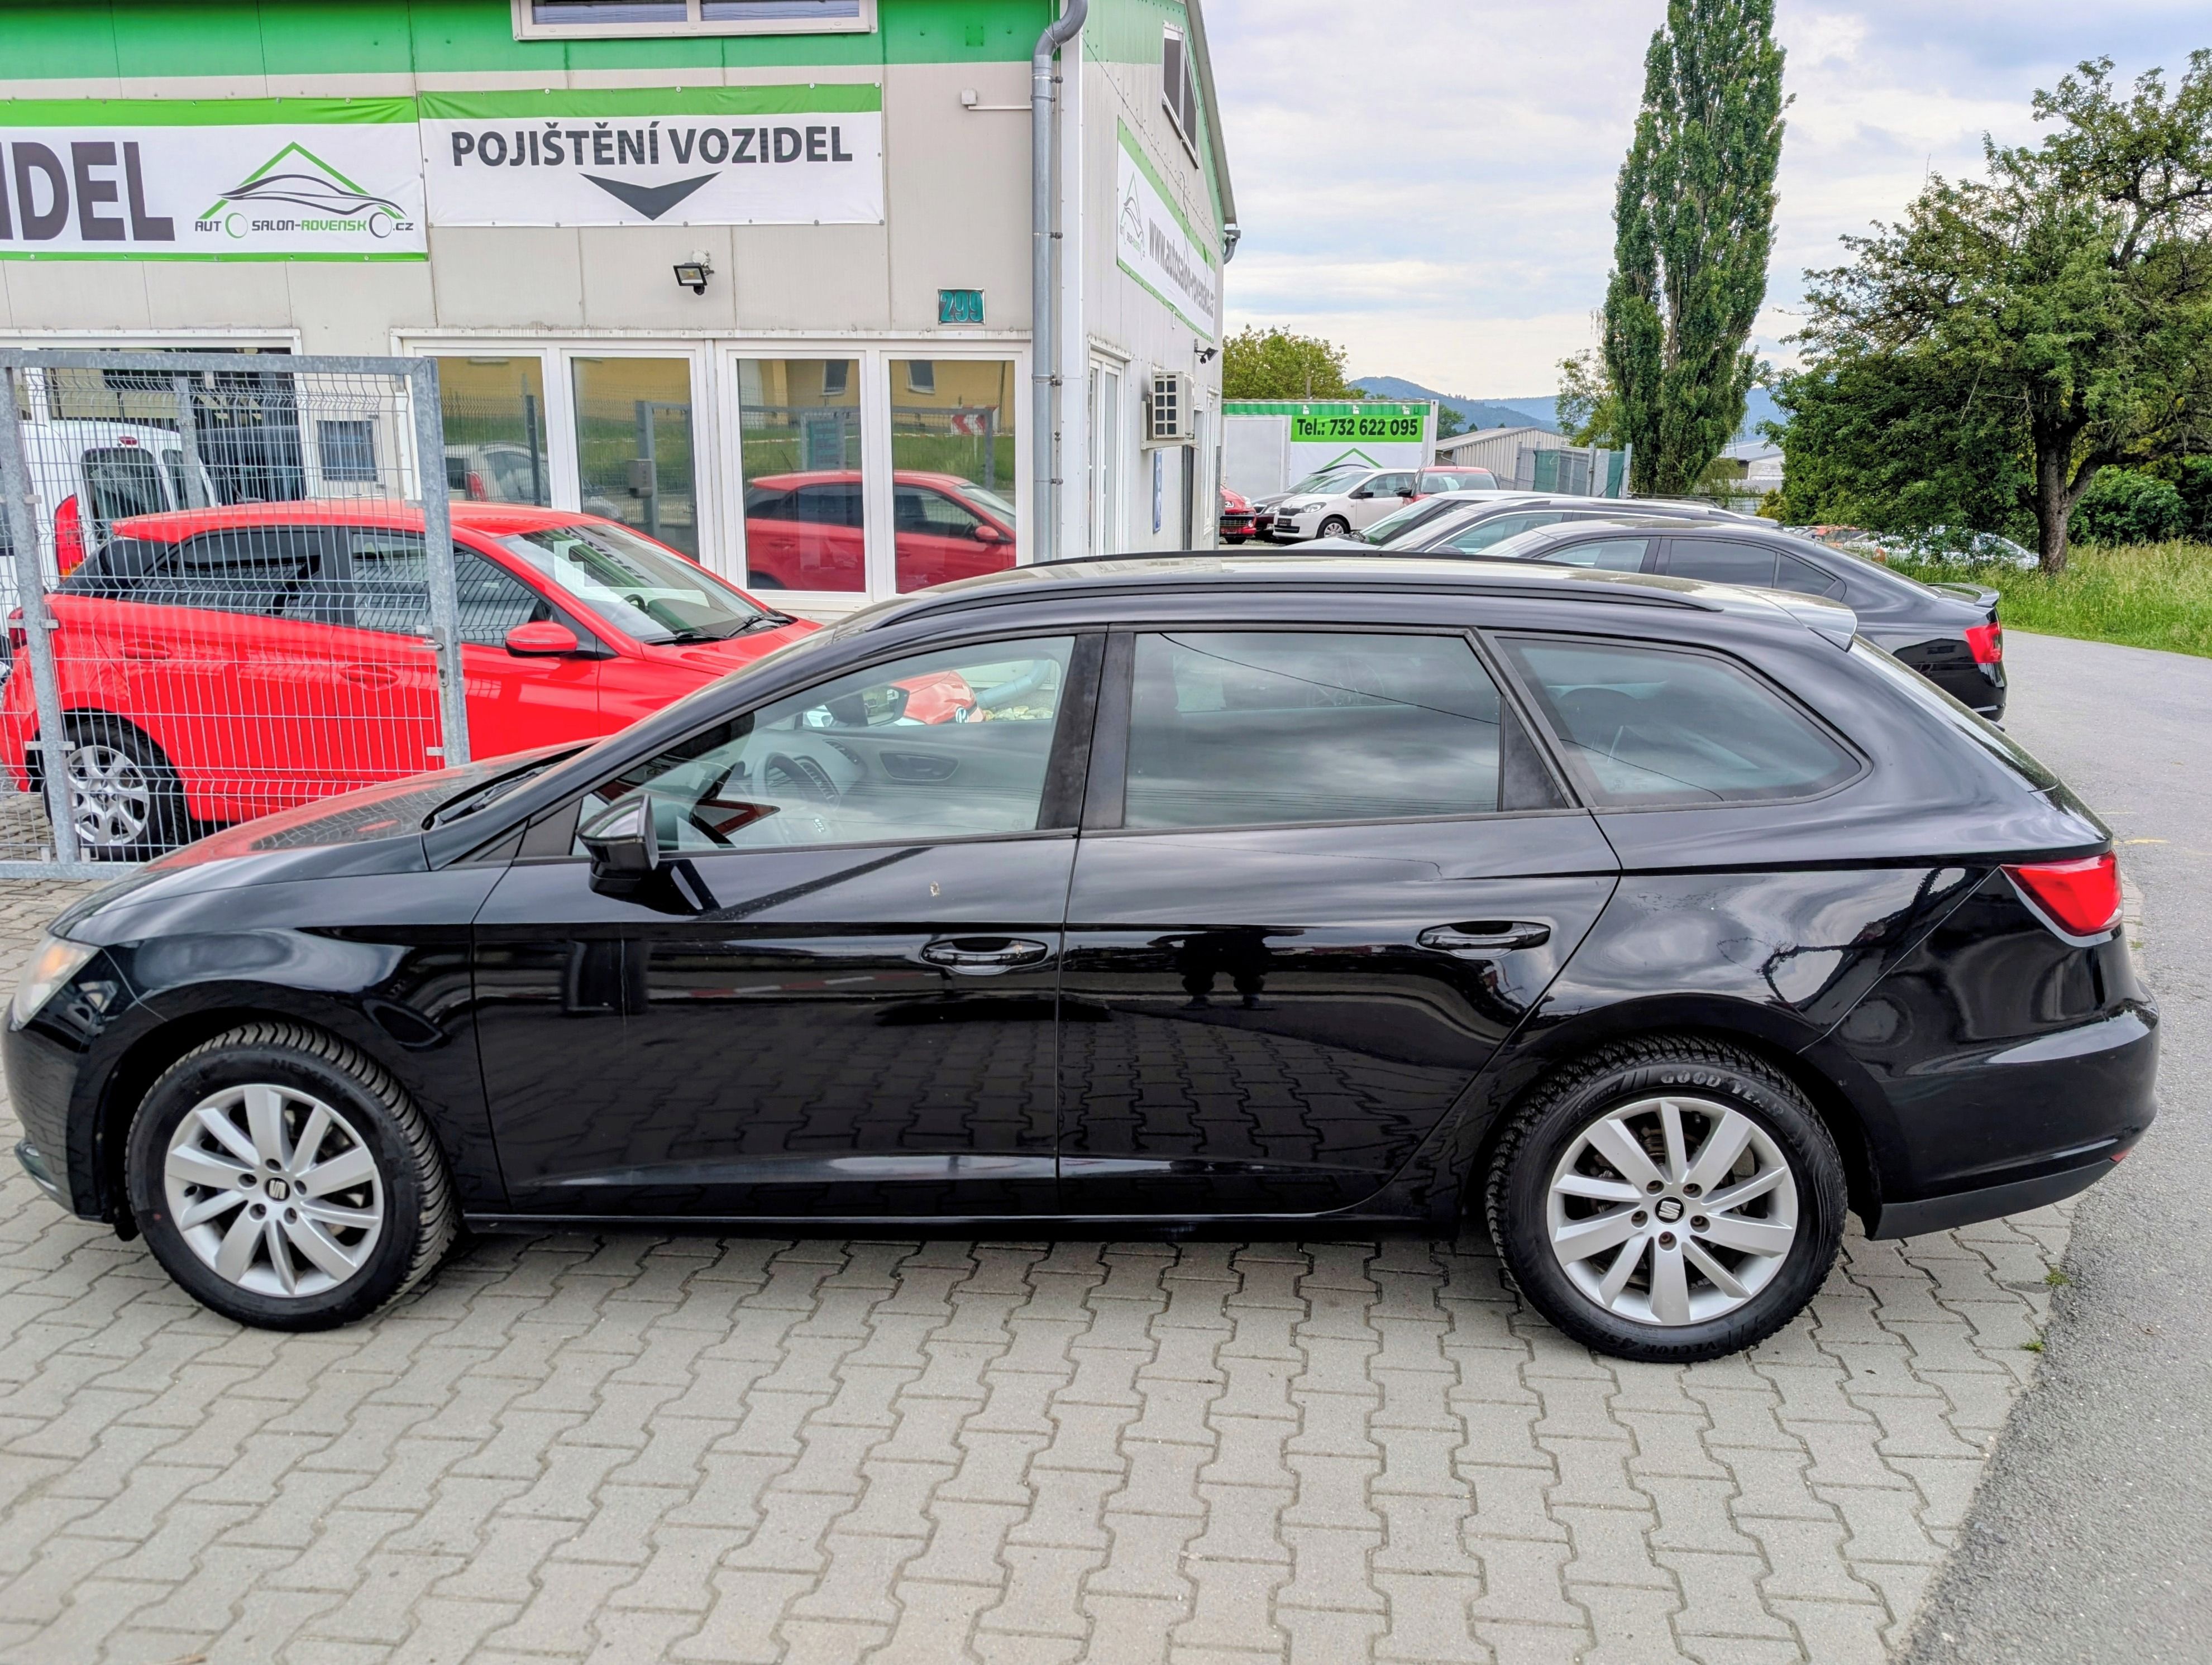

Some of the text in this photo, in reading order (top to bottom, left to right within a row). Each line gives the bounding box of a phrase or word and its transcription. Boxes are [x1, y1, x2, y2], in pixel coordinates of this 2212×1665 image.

[452, 121, 853, 166] POJIŠTĚNÍ VOZIDEL
[1149, 217, 1214, 319] www.autosalon-rovensko.cz
[940, 291, 983, 322] 299
[1297, 418, 1418, 436] Tel.: 732 622 095
[1660, 1070, 1722, 1088] GOOD
